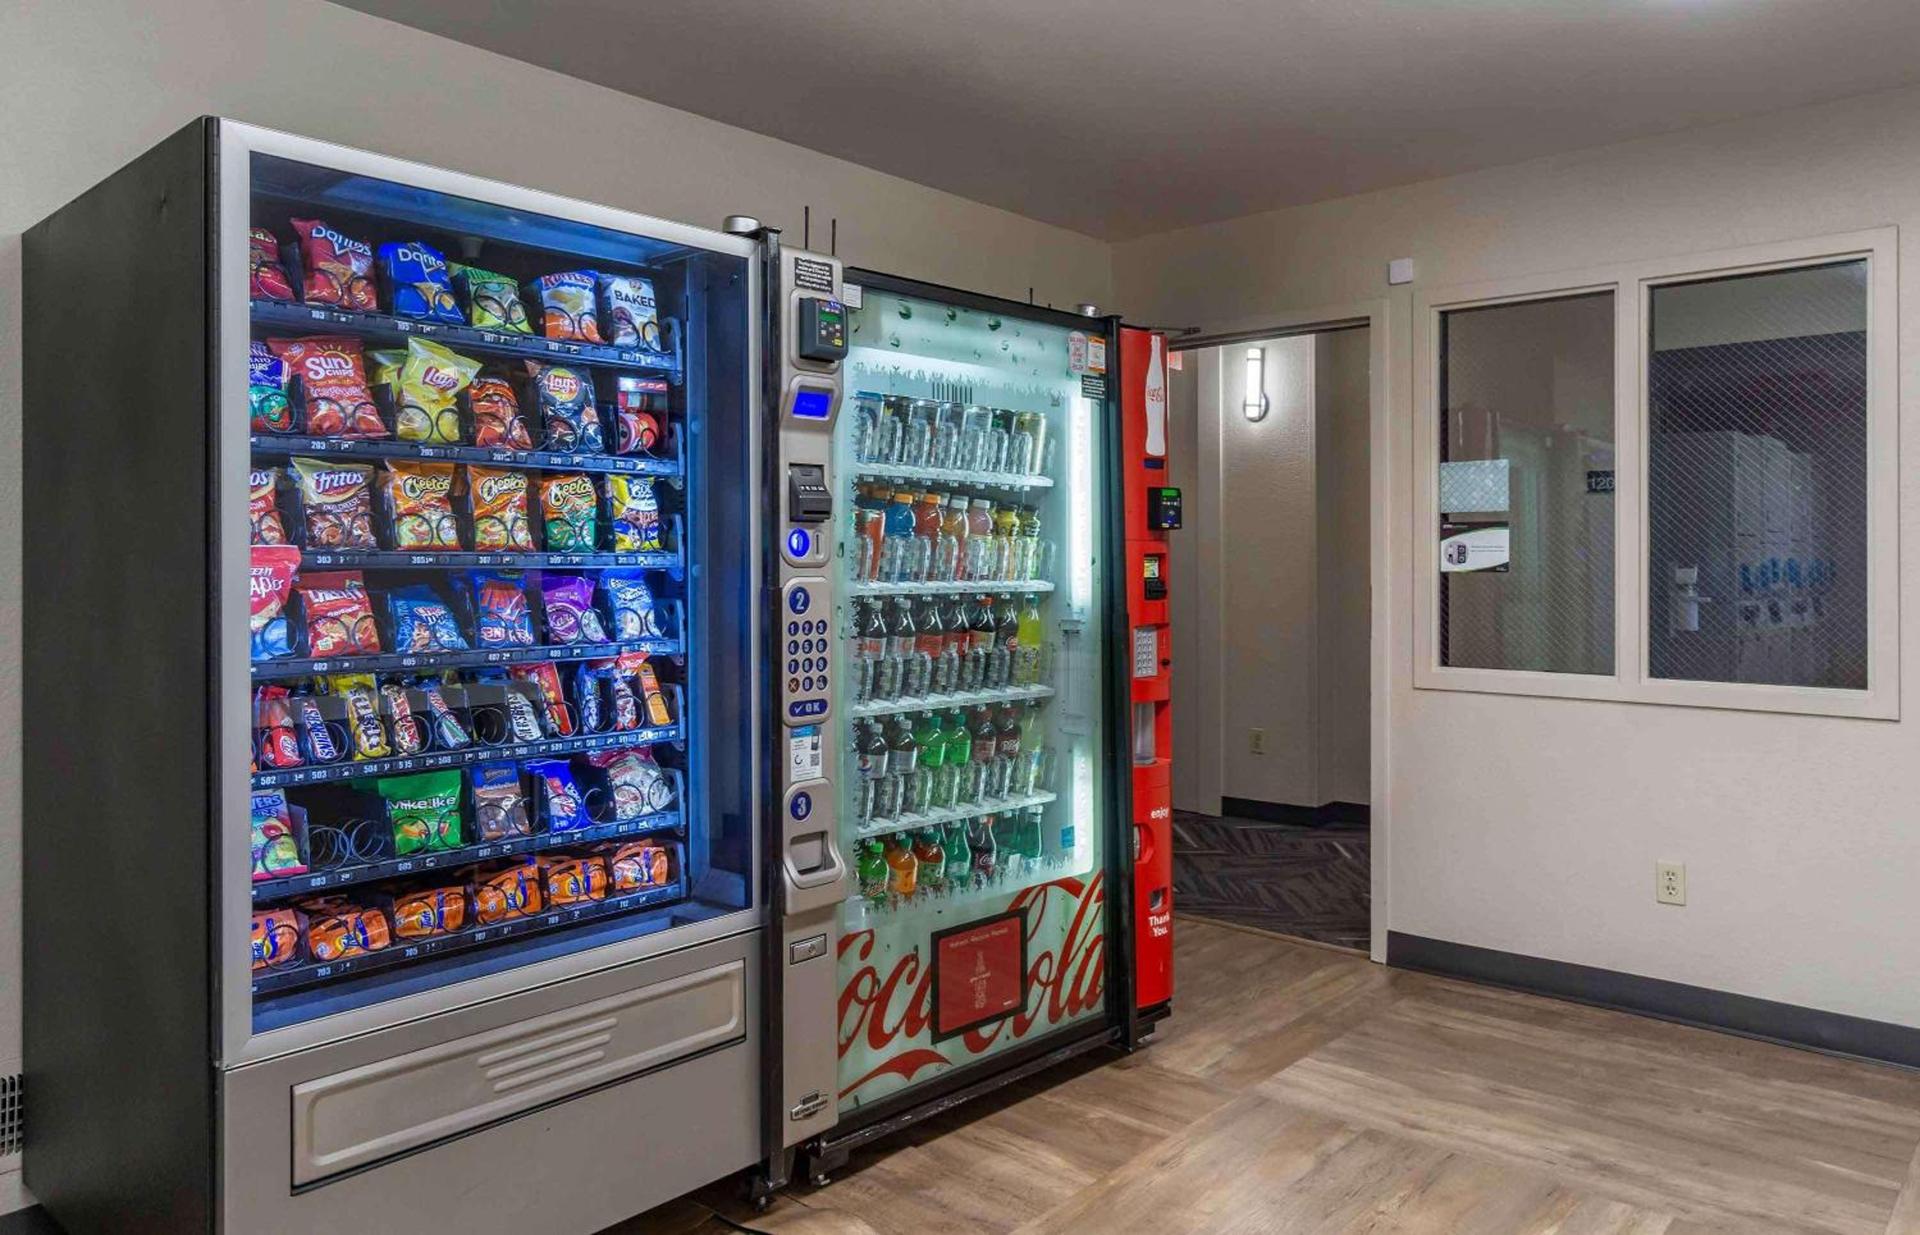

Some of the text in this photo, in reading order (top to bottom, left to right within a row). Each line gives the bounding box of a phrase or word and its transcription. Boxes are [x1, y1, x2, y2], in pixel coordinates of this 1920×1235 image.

[398, 248, 446, 271] Dorito
[613, 290, 656, 307] BAKED
[305, 355, 353, 380] Sun
[423, 367, 459, 390] Lay's
[311, 441, 326, 450] 203
[312, 470, 364, 494] Fritos
[403, 475, 450, 499] Cheetos
[480, 473, 527, 503] Cheetos
[549, 477, 594, 507] Cheetos
[316, 555, 332, 564] 303
[795, 592, 805, 610] 2
[805, 702, 820, 713] OK
[304, 707, 335, 760] SNICKERS
[260, 776, 276, 786] 502
[311, 771, 328, 780] 503
[797, 797, 806, 816] 3
[1150, 806, 1169, 819] enjoy
[1153, 926, 1168, 937] You
